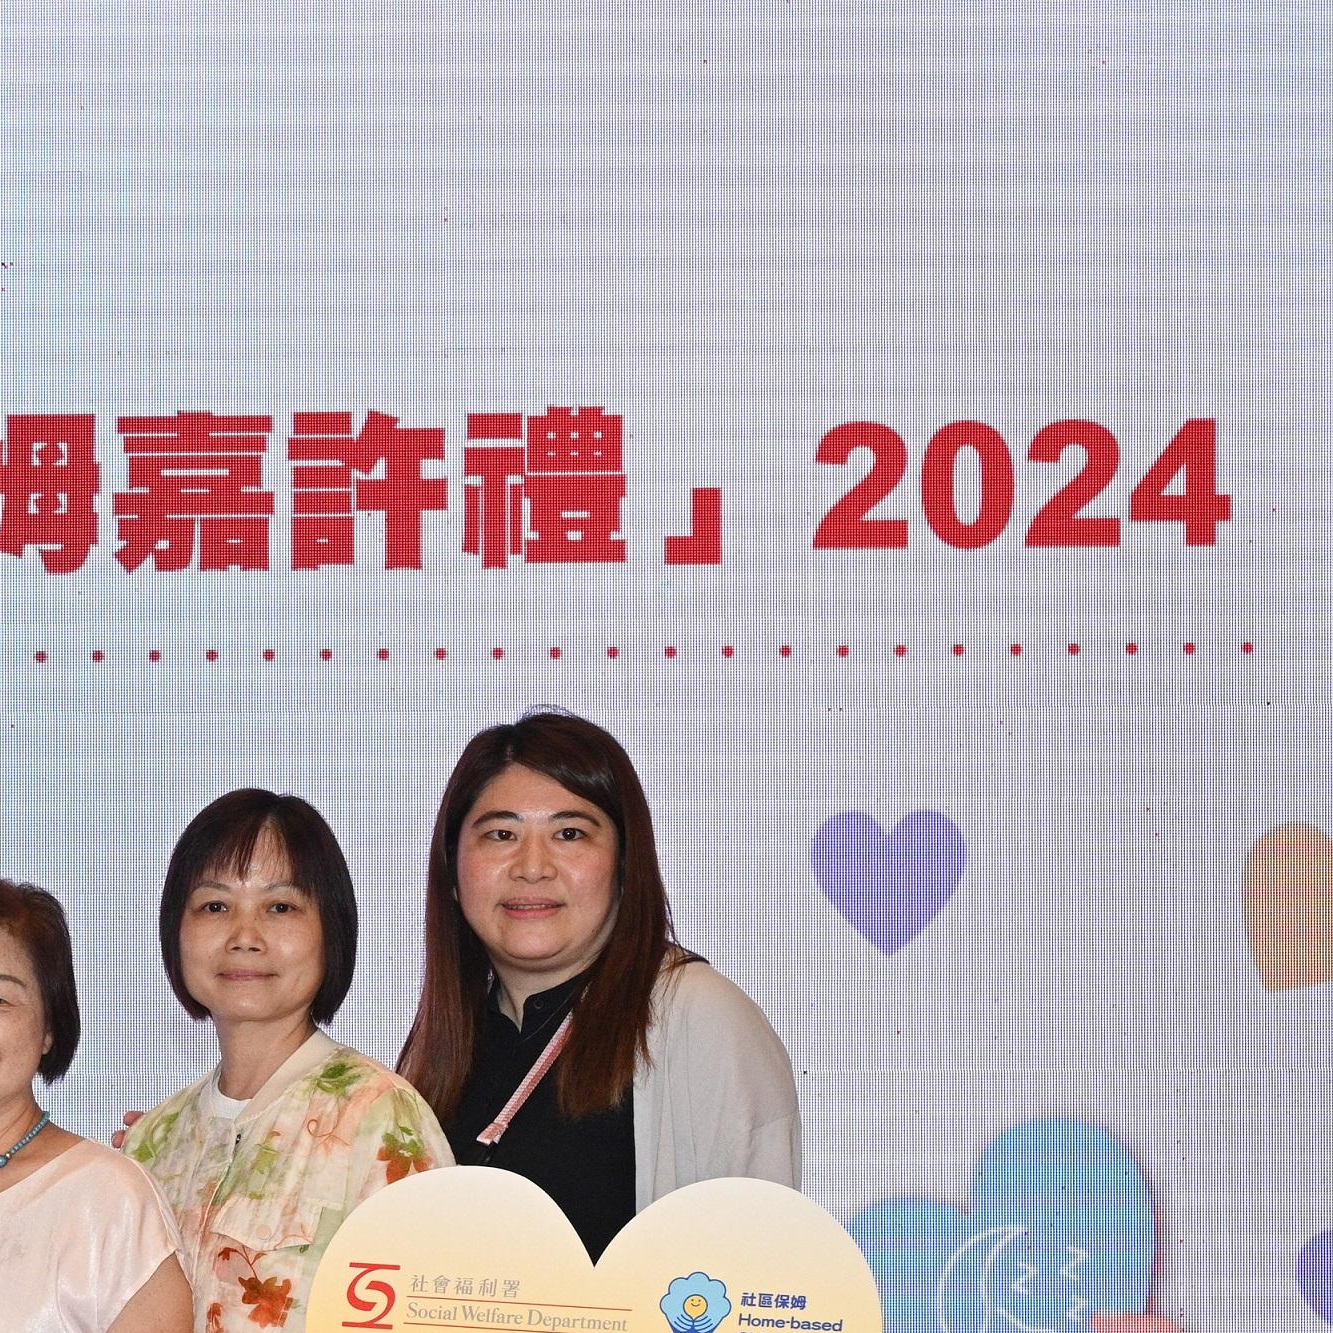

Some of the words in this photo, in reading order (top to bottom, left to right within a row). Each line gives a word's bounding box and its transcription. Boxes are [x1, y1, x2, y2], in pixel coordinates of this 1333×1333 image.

[815, 420, 1230, 548] 2024
[411, 1274, 520, 1298] 社會福利署
[740, 1292, 807, 1311] 社區保姆
[406, 1302, 458, 1321] Social
[461, 1305, 523, 1325] Welfare
[527, 1309, 628, 1332] Department
[738, 1313, 843, 1332] Home-based
